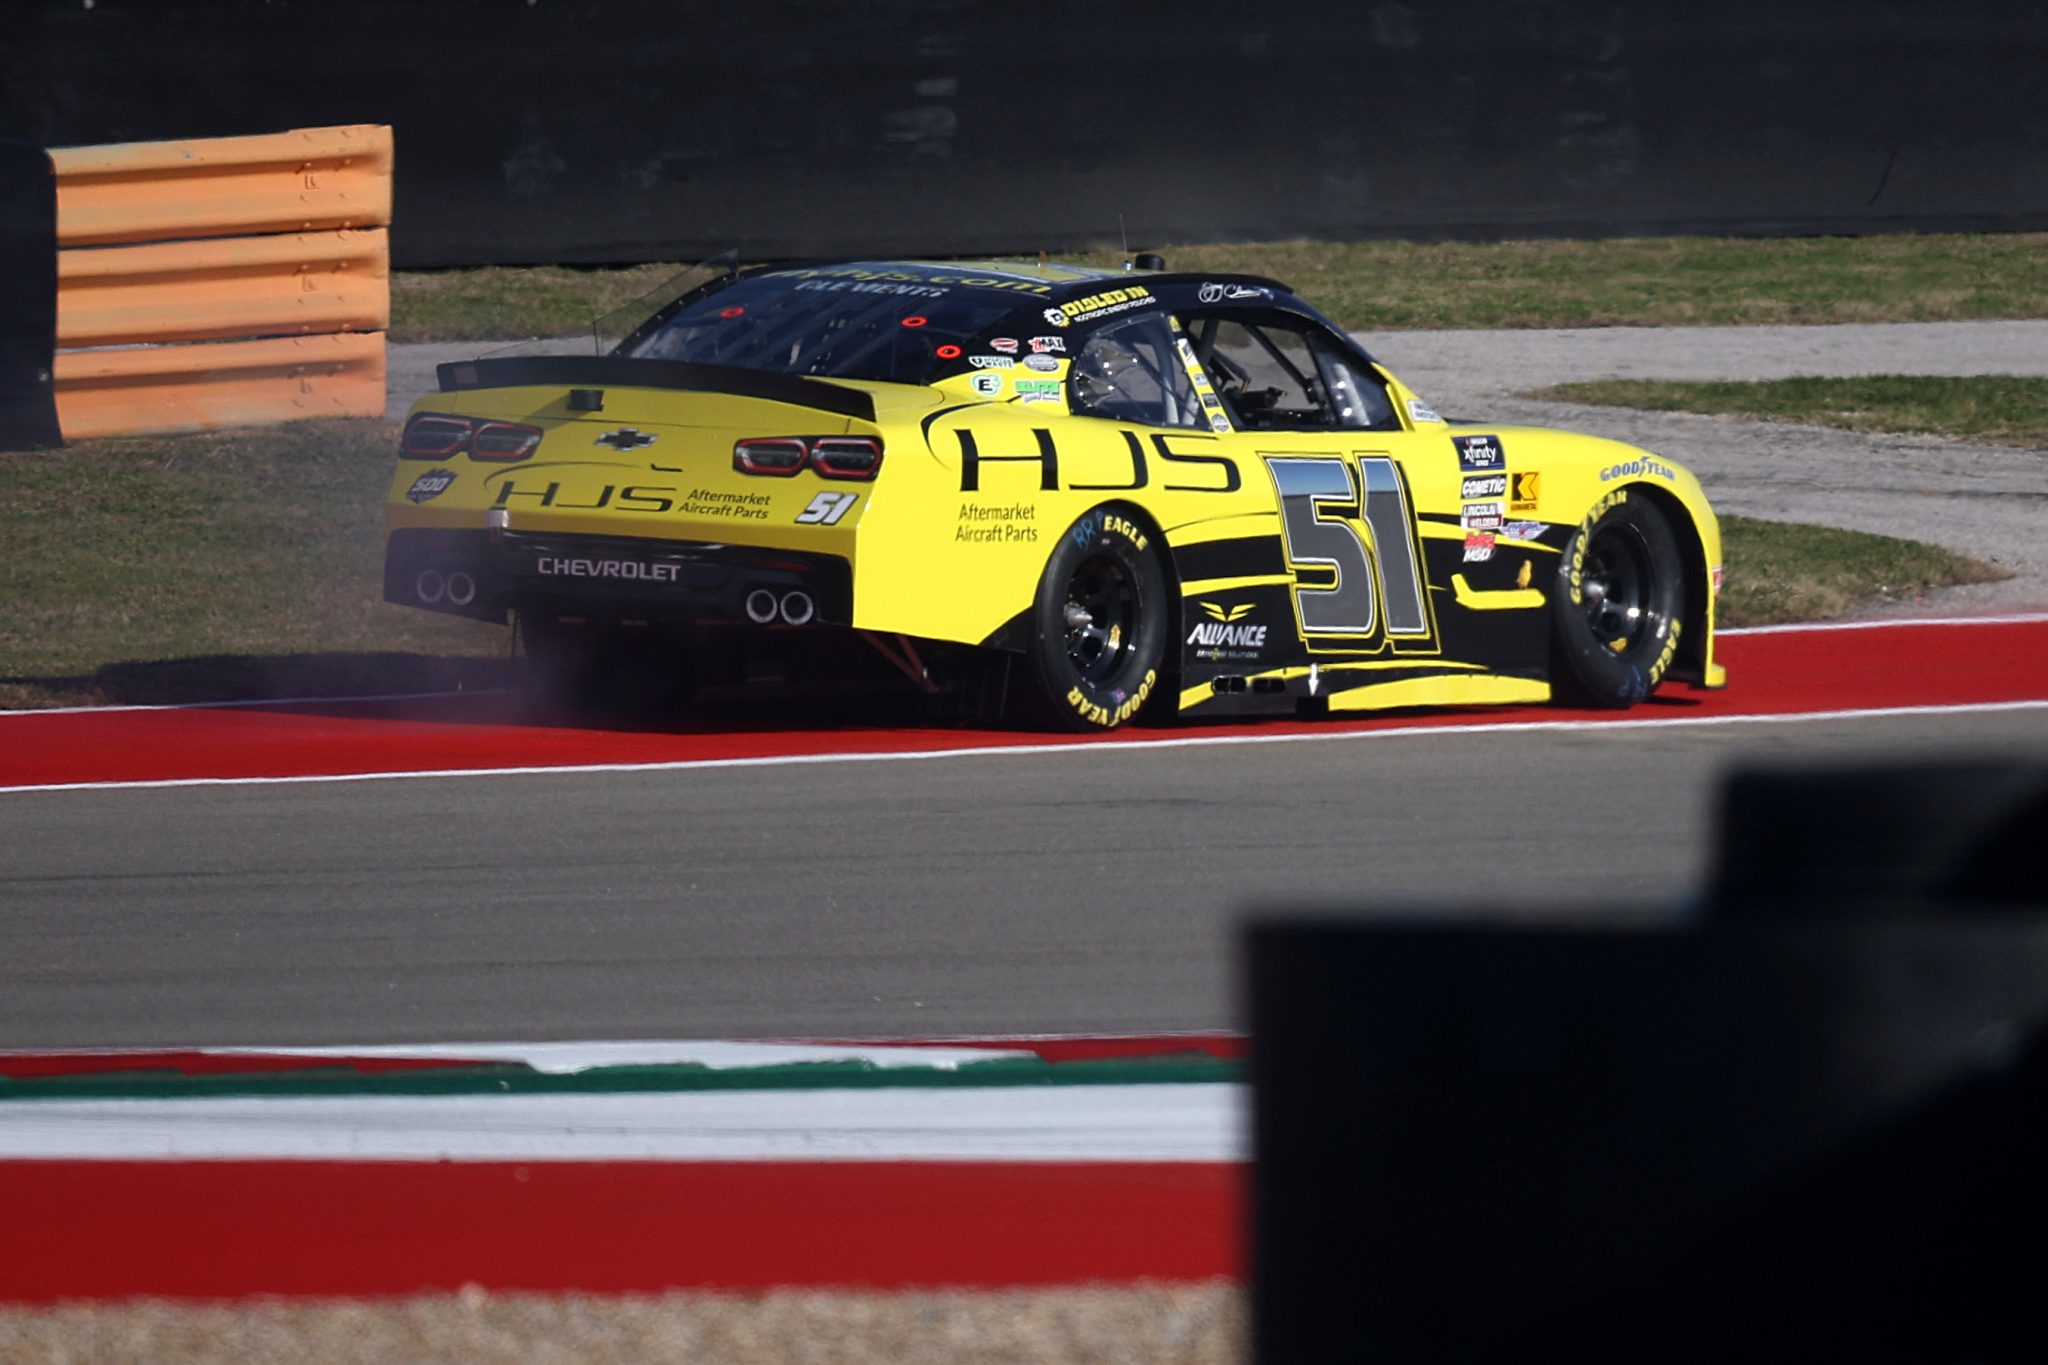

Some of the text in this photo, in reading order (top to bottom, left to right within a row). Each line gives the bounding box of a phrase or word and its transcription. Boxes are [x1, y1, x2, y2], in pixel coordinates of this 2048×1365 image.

[794, 279, 949, 298] CLEMENTS
[954, 428, 1241, 492] HJS
[1463, 444, 1496, 463] xfinity
[1600, 457, 1675, 481] GOODYEAR
[490, 480, 677, 513] HJS
[687, 489, 771, 506] Aftermarket
[1461, 477, 1506, 499] COMETIC
[679, 502, 769, 519] Aircraft Parts
[794, 490, 860, 525] 51
[959, 502, 1035, 520] Aftermarket
[955, 523, 1038, 542] Aircraft Parts
[1103, 514, 1148, 552] EAGLE
[1262, 453, 1432, 642] 51
[1463, 547, 1492, 562] MSD
[1570, 490, 1627, 605] GOODYEAR
[537, 557, 682, 581] CHEVROLET
[1186, 622, 1268, 647] ALLIANCE
[1067, 669, 1156, 727] GOODYEAR
